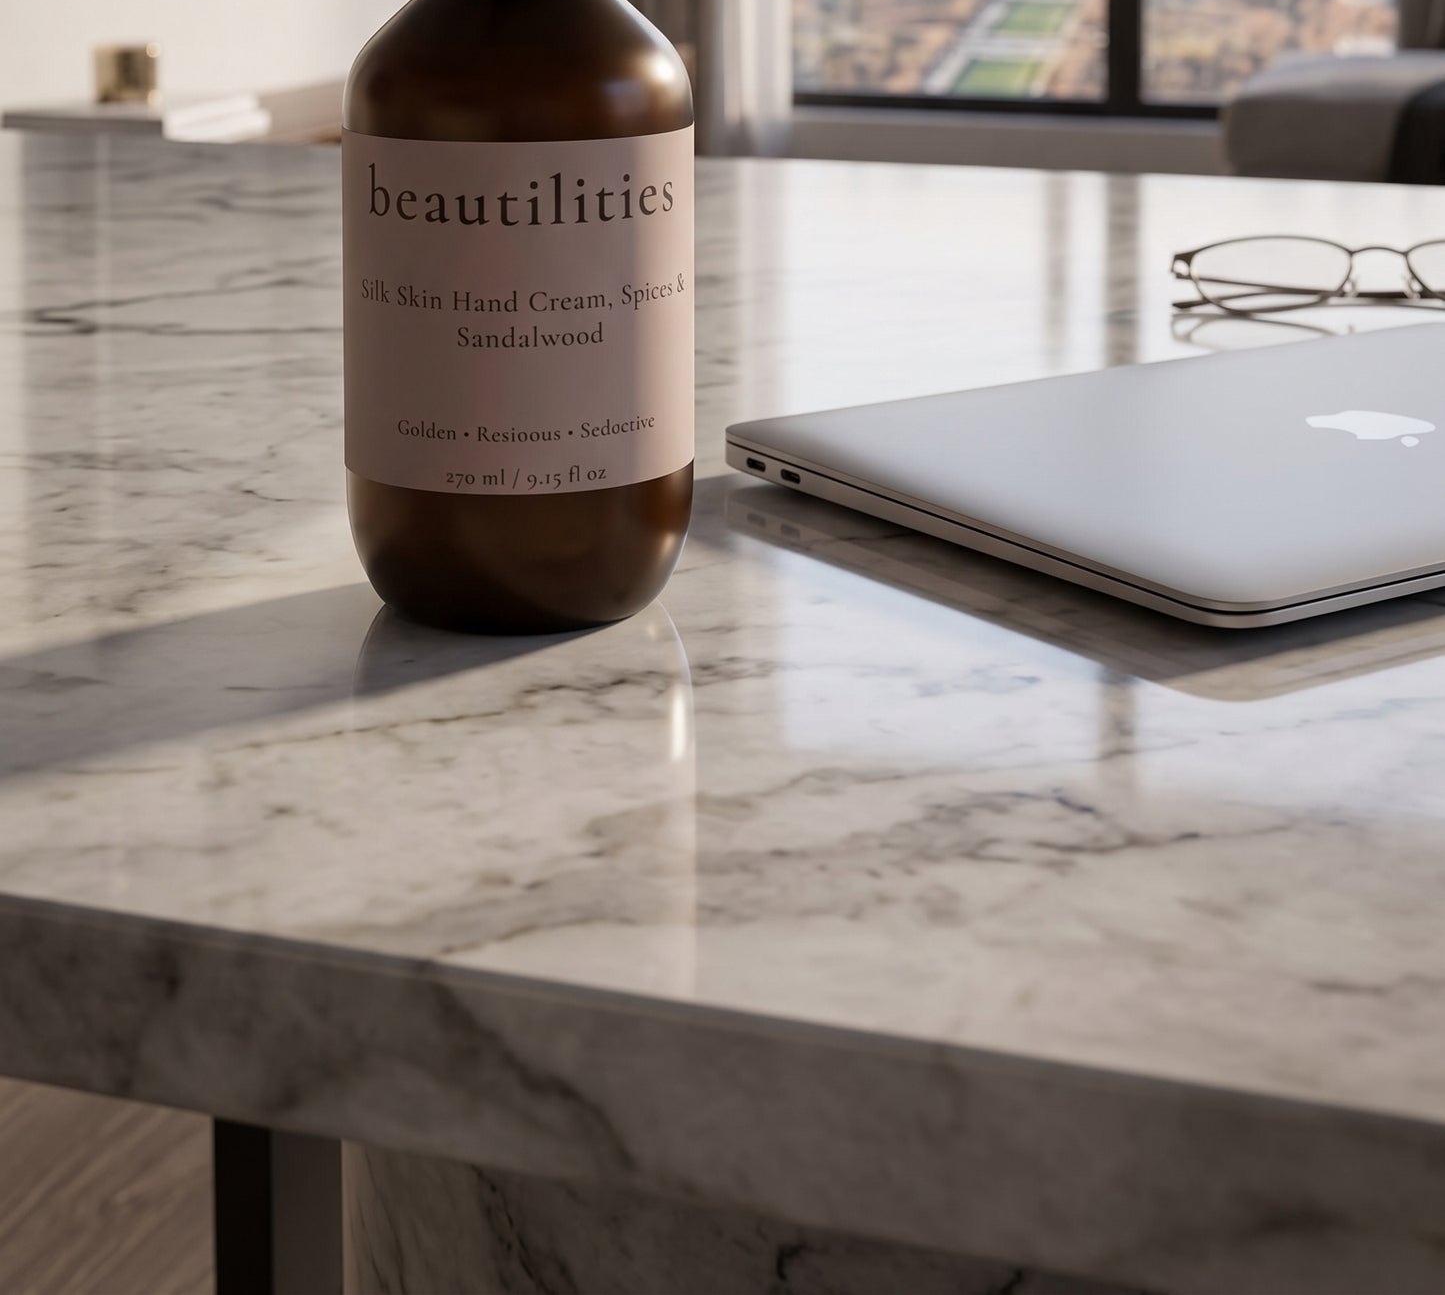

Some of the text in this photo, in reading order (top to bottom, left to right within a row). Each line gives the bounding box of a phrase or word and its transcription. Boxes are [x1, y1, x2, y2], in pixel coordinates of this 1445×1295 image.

[368, 162, 674, 227] beautilities
[361, 272, 685, 313] Silk Skin Hand Cream, Spices &
[457, 321, 604, 349] Sandalwood
[397, 419, 457, 441] Golden
[446, 464, 607, 490] 270 ml / 9.15 fl oz
